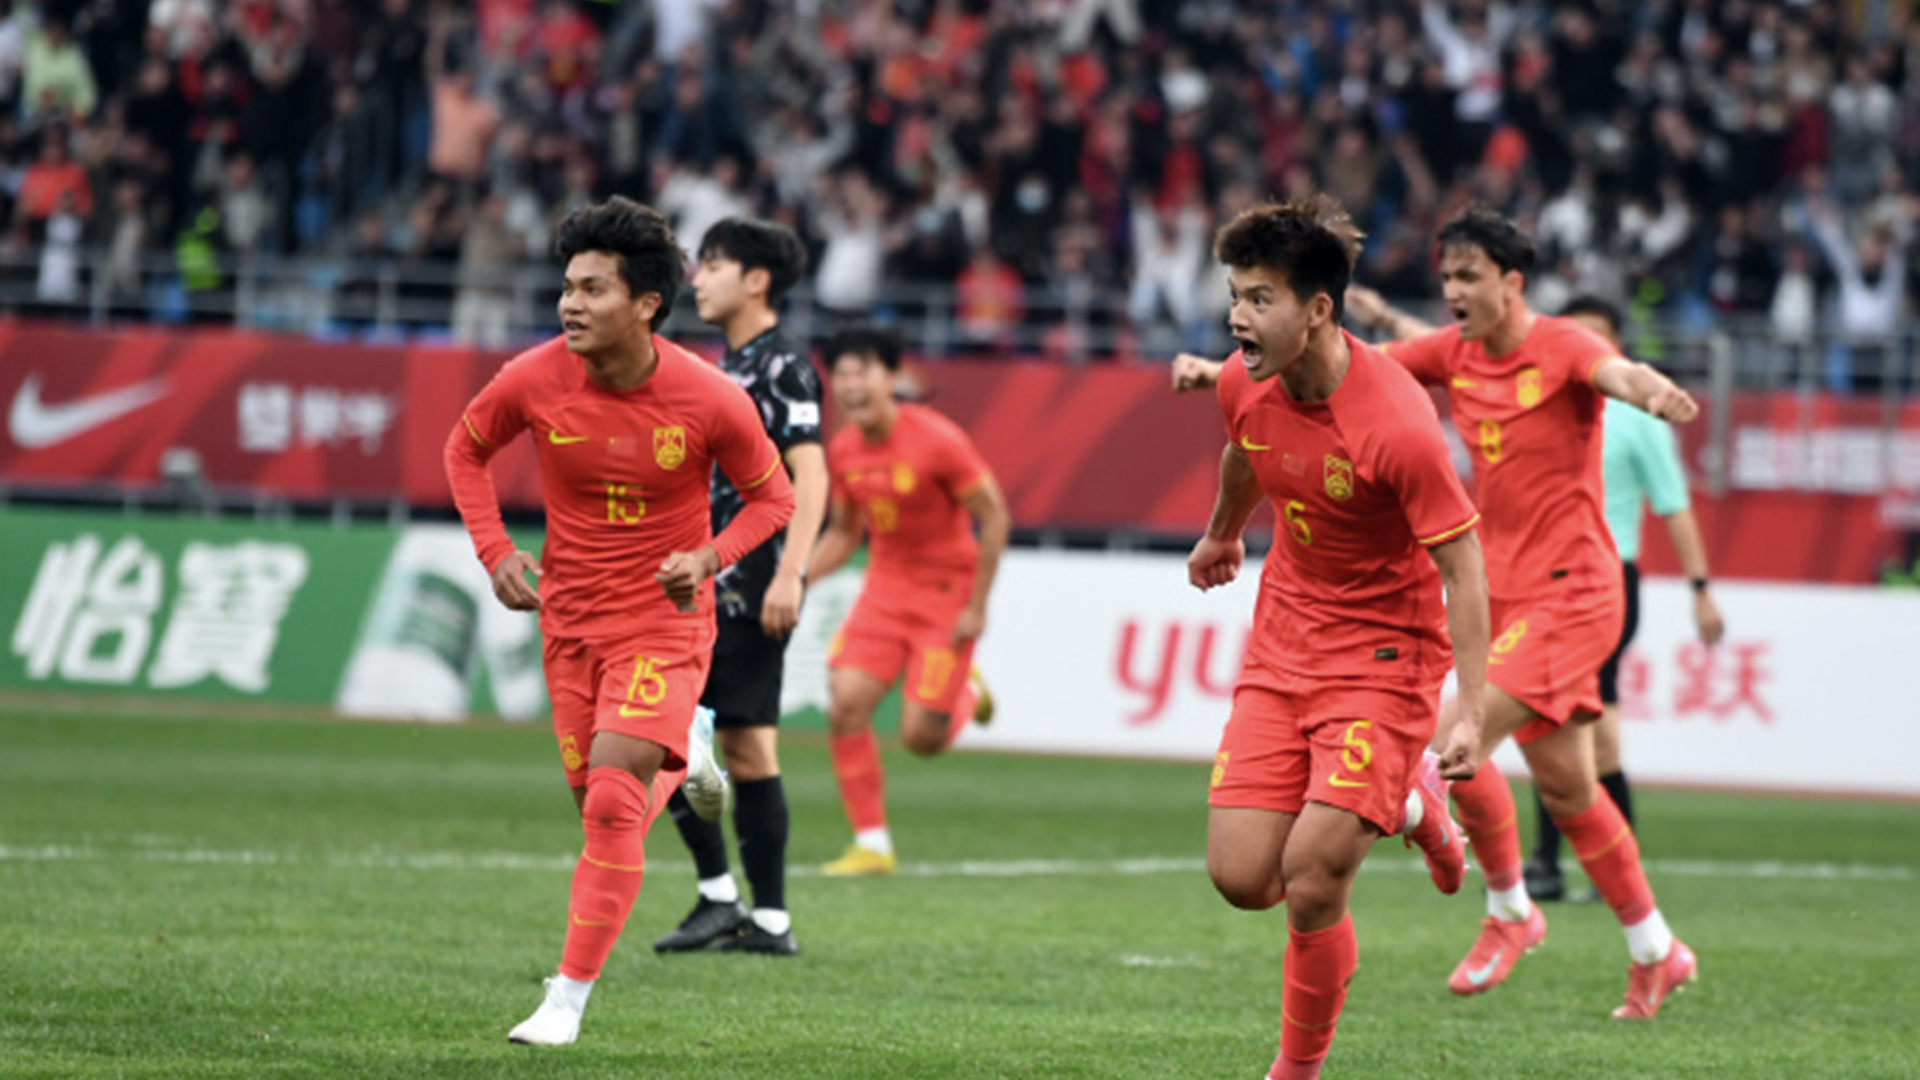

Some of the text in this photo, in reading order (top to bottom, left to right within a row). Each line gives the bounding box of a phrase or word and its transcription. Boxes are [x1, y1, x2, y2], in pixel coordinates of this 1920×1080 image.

[1479, 418, 1501, 463] 8
[603, 481, 646, 524] 15
[1284, 500, 1313, 546] 5
[11, 534, 310, 693] 怡寶
[1493, 619, 1528, 653] 8
[627, 655, 671, 704] 15
[1341, 720, 1373, 771] 5
